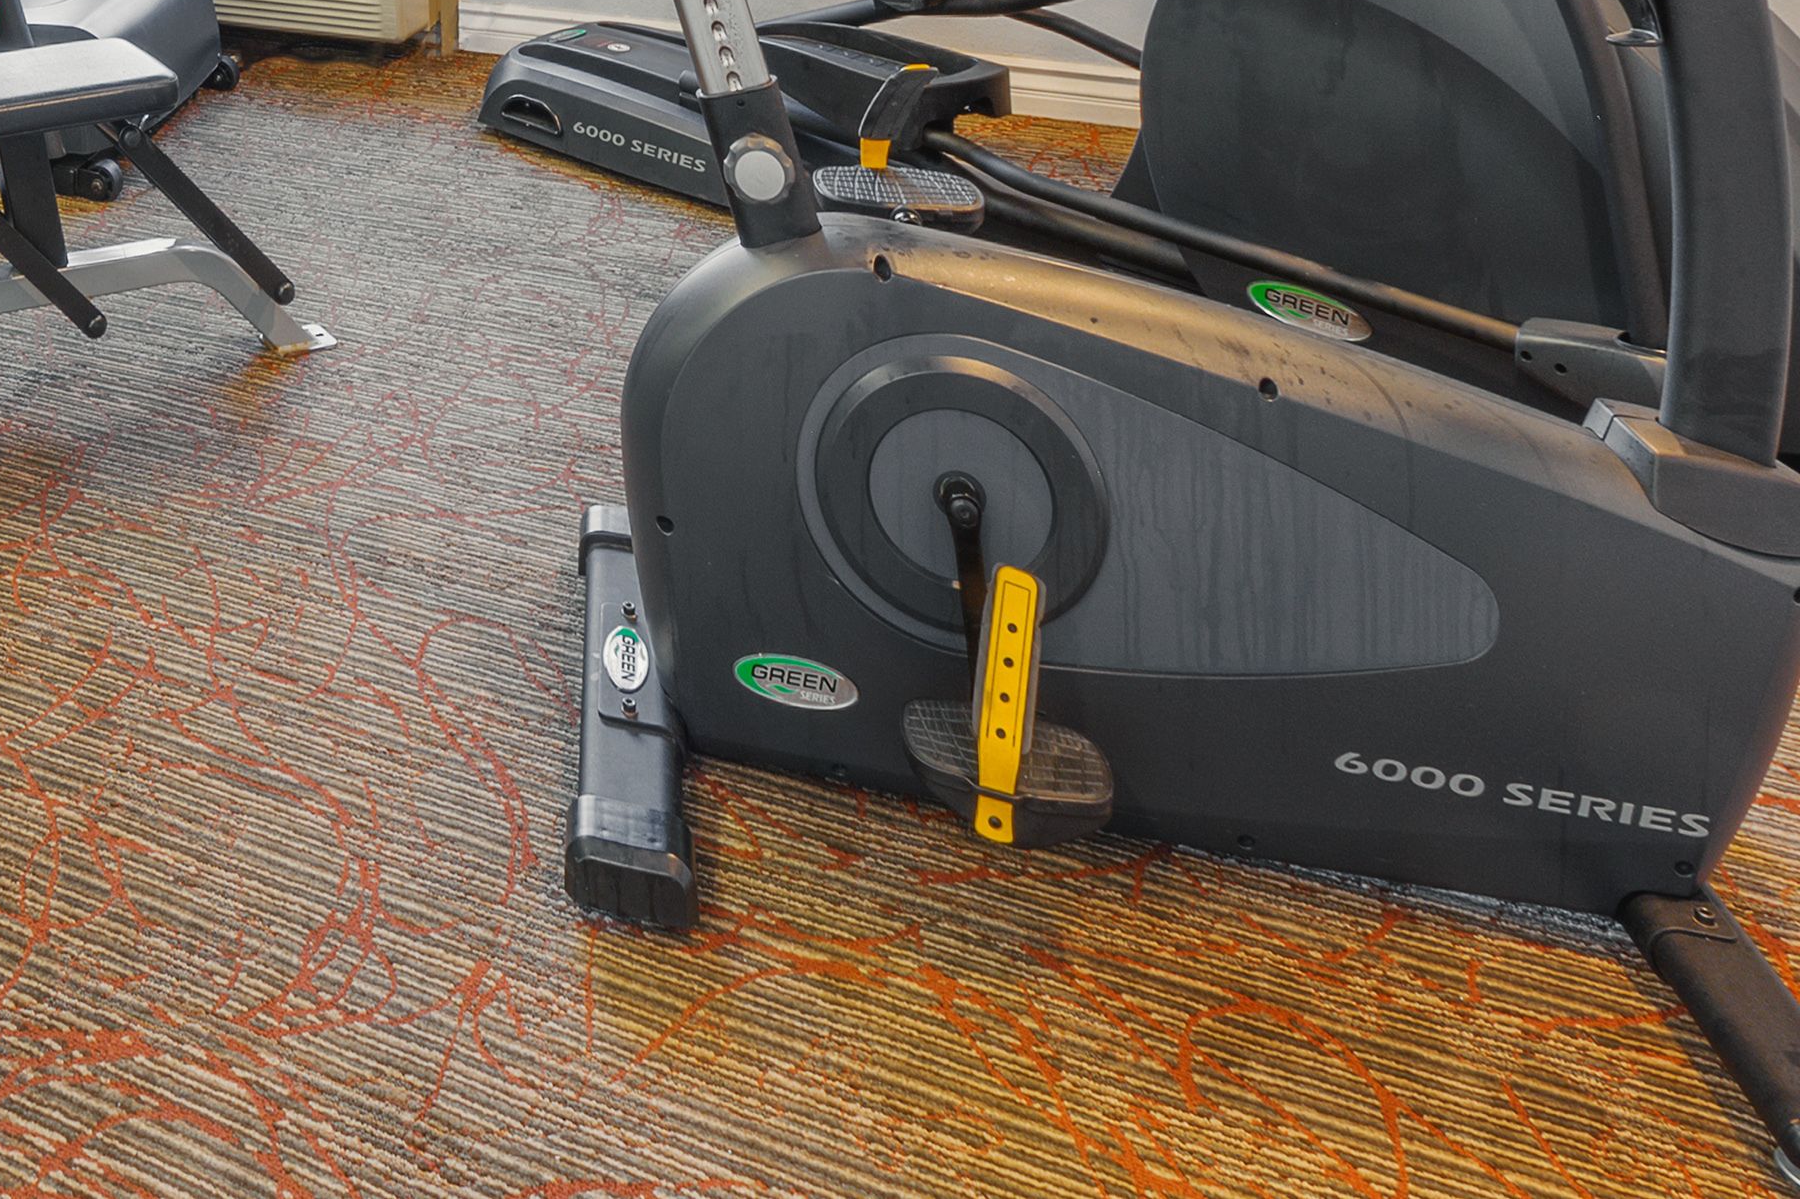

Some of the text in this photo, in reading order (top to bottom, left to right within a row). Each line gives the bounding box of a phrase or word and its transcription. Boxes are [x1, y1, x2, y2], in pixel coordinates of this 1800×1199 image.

[573, 121, 706, 173] 6000 SERIES
[1264, 288, 1349, 326] GREEN
[622, 635, 636, 683] GREEN
[751, 664, 840, 694] GREEN
[800, 689, 836, 705] SERIES
[1334, 751, 1711, 839] 6000 SERIES
